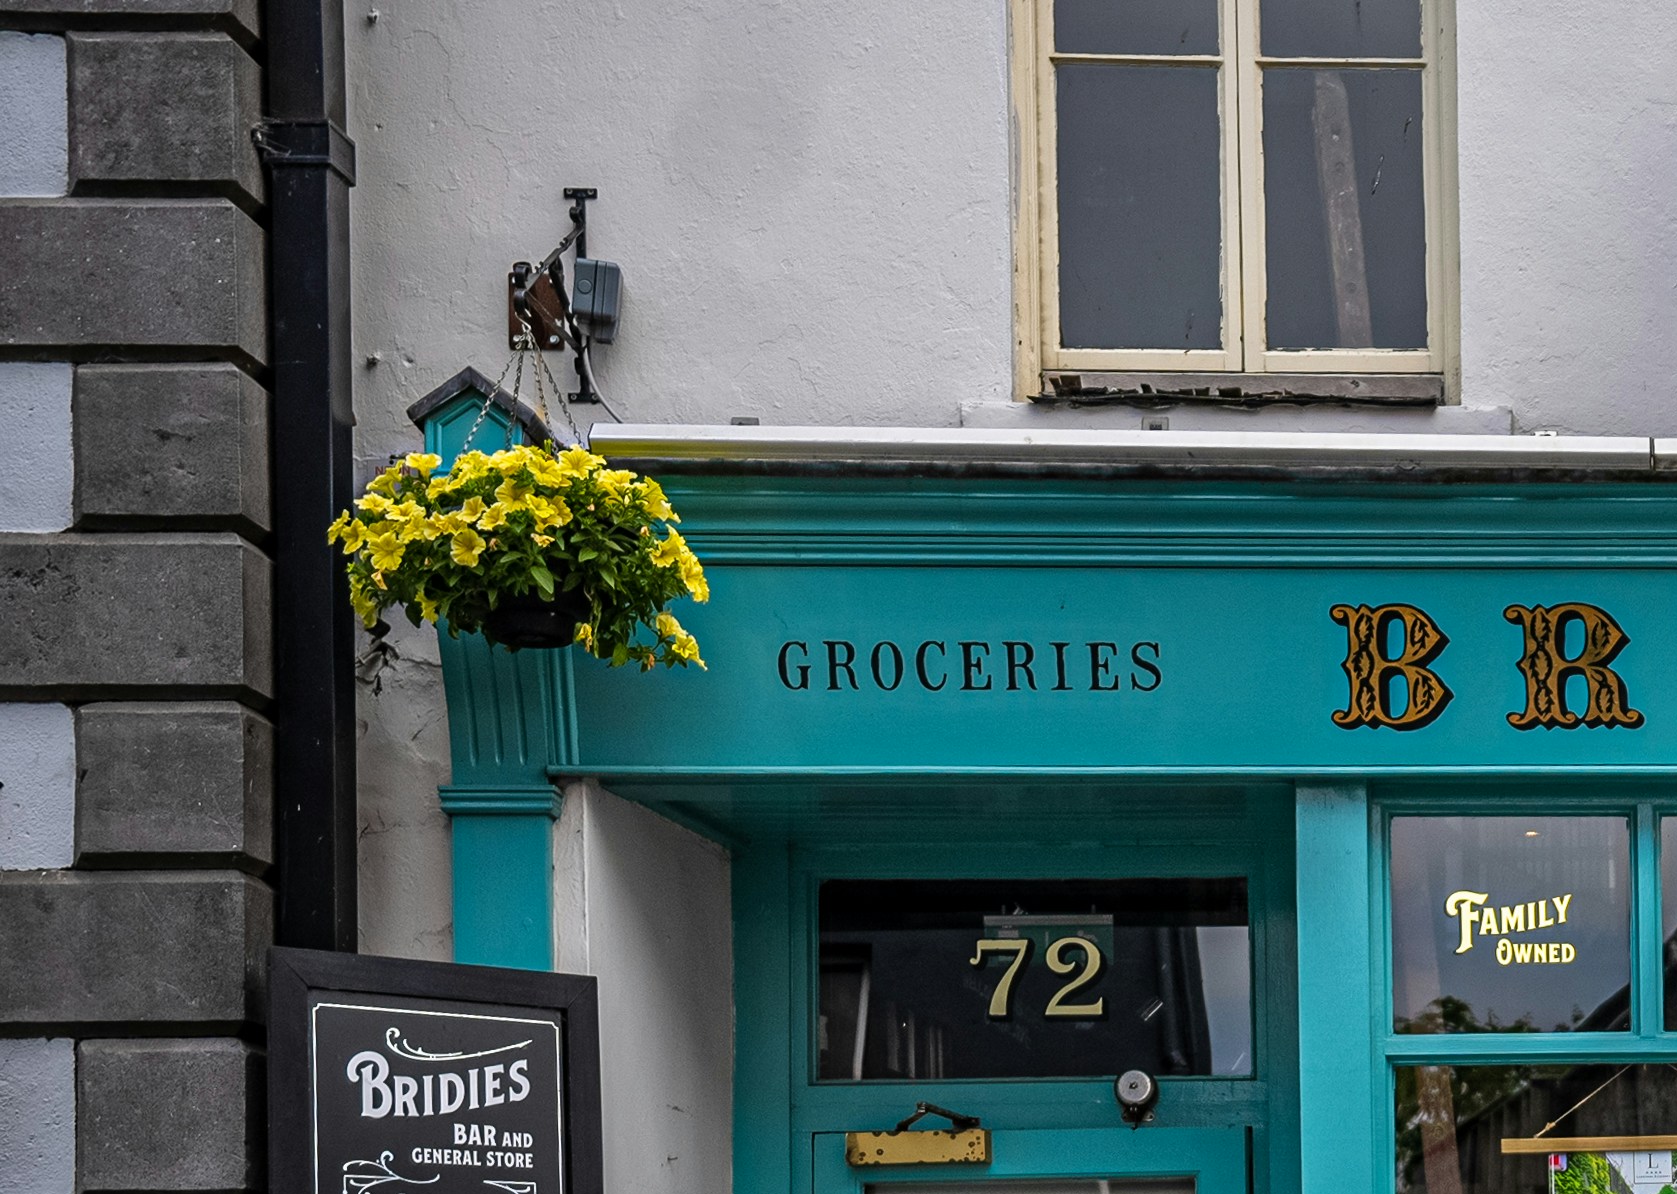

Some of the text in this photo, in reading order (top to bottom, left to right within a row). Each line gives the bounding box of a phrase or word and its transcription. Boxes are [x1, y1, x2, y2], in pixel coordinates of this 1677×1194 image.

[777, 640, 1162, 692] GROCERIES
[1445, 890, 1572, 954] FAMILY
[969, 936, 1104, 1017] 72
[1496, 938, 1576, 966] OWNED
[346, 1049, 531, 1119] BRIDIES
[412, 1148, 534, 1168] GENERAL STORE
[453, 1123, 533, 1148] BAR AND
